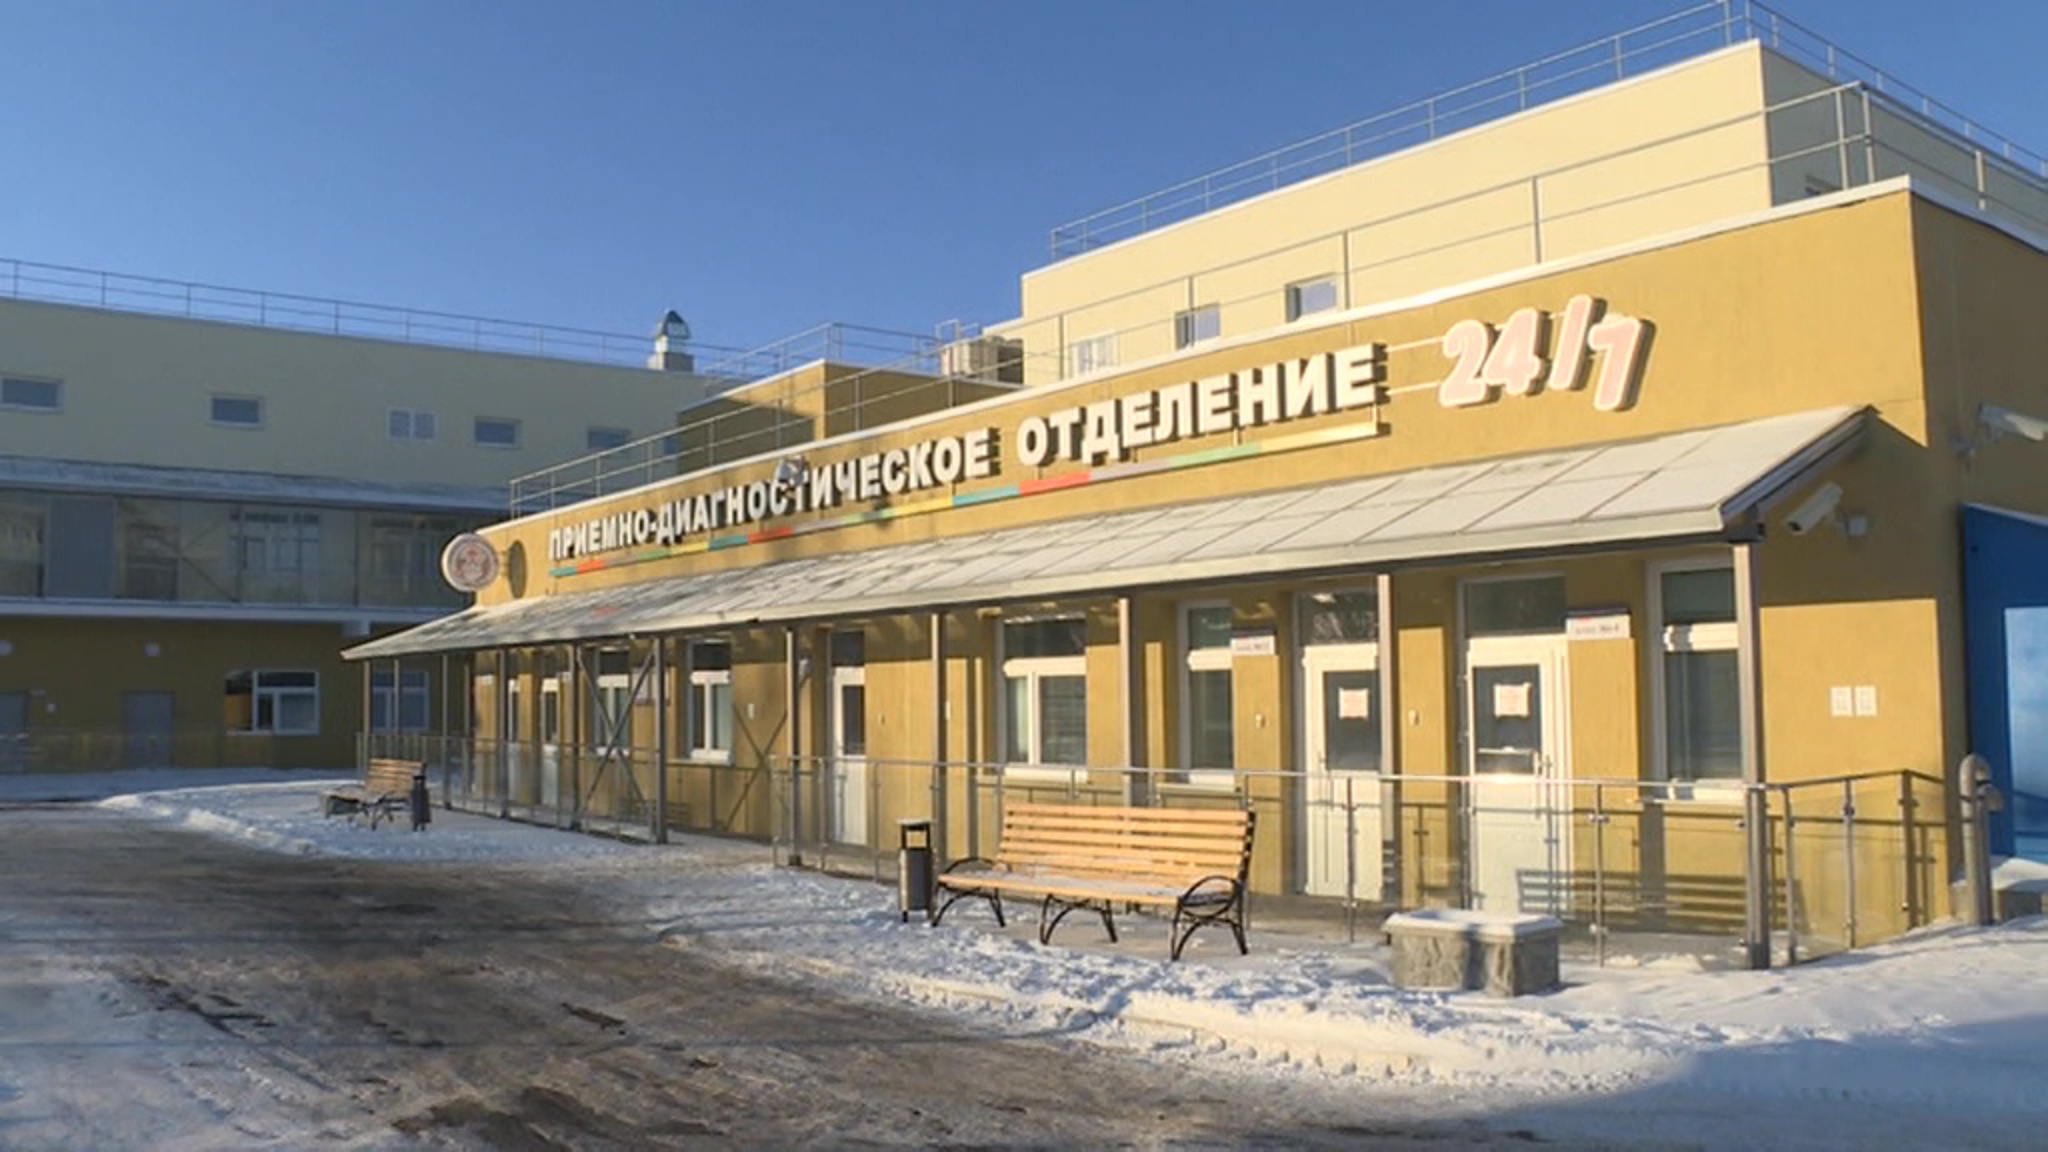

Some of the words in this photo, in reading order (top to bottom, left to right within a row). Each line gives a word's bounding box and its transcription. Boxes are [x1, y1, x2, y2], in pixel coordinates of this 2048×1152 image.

[549, 428, 993, 559] ПРИЕМНО-ДИАГНОСТИЧЕСКОЕ
[1017, 344, 1379, 465] ОТДЕЛЕНИЕ
[1438, 294, 1648, 411] 24/7
